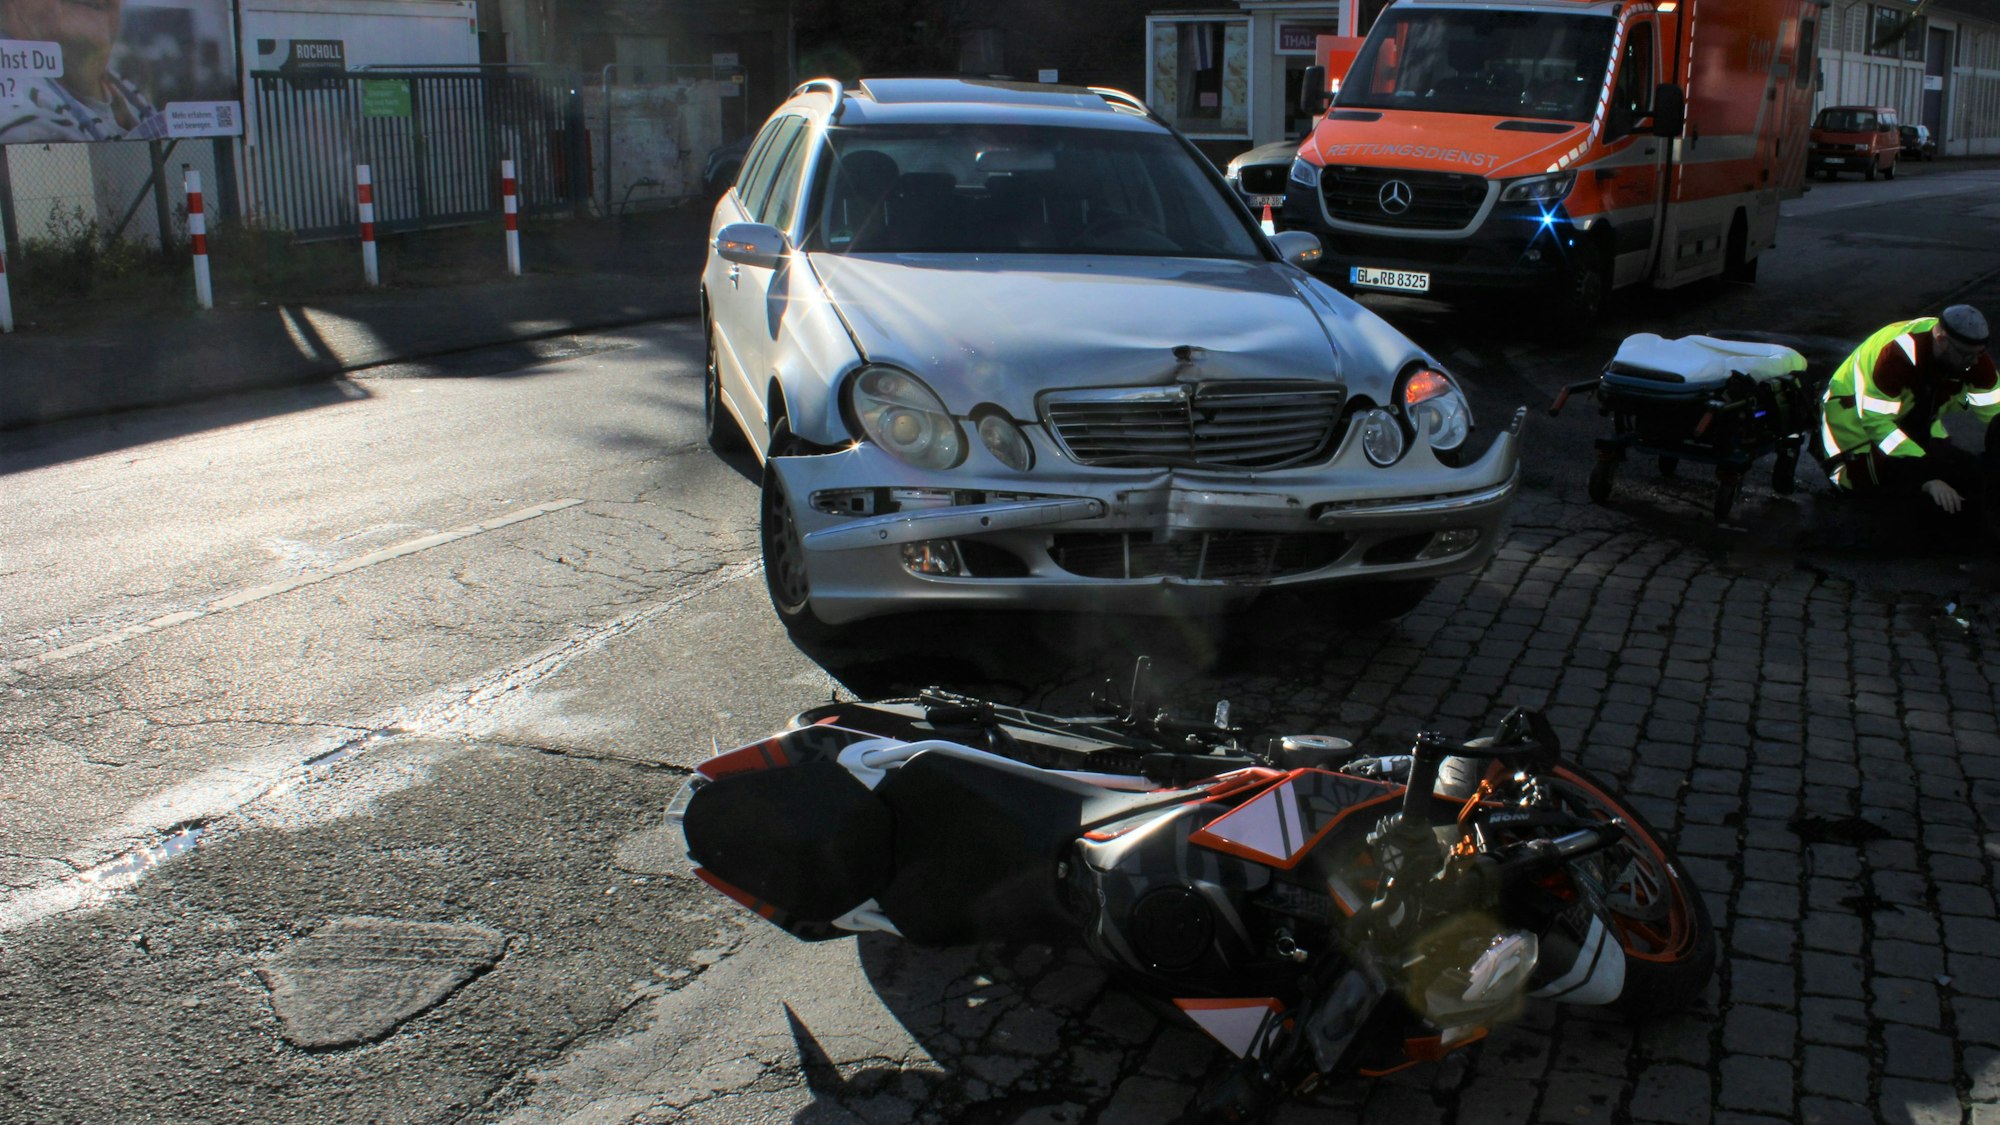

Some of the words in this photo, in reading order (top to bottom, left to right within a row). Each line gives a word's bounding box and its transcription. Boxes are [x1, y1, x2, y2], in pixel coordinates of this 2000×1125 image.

[32, 50, 56, 70] Du
[296, 44, 341, 59] ROCHOLL
[172, 111, 187, 119] Mehr
[1325, 143, 1500, 169] RETTUNGSDIENST
[1356, 268, 1372, 284] GL
[1380, 270, 1395, 286] RB
[1396, 272, 1427, 289] 8325
